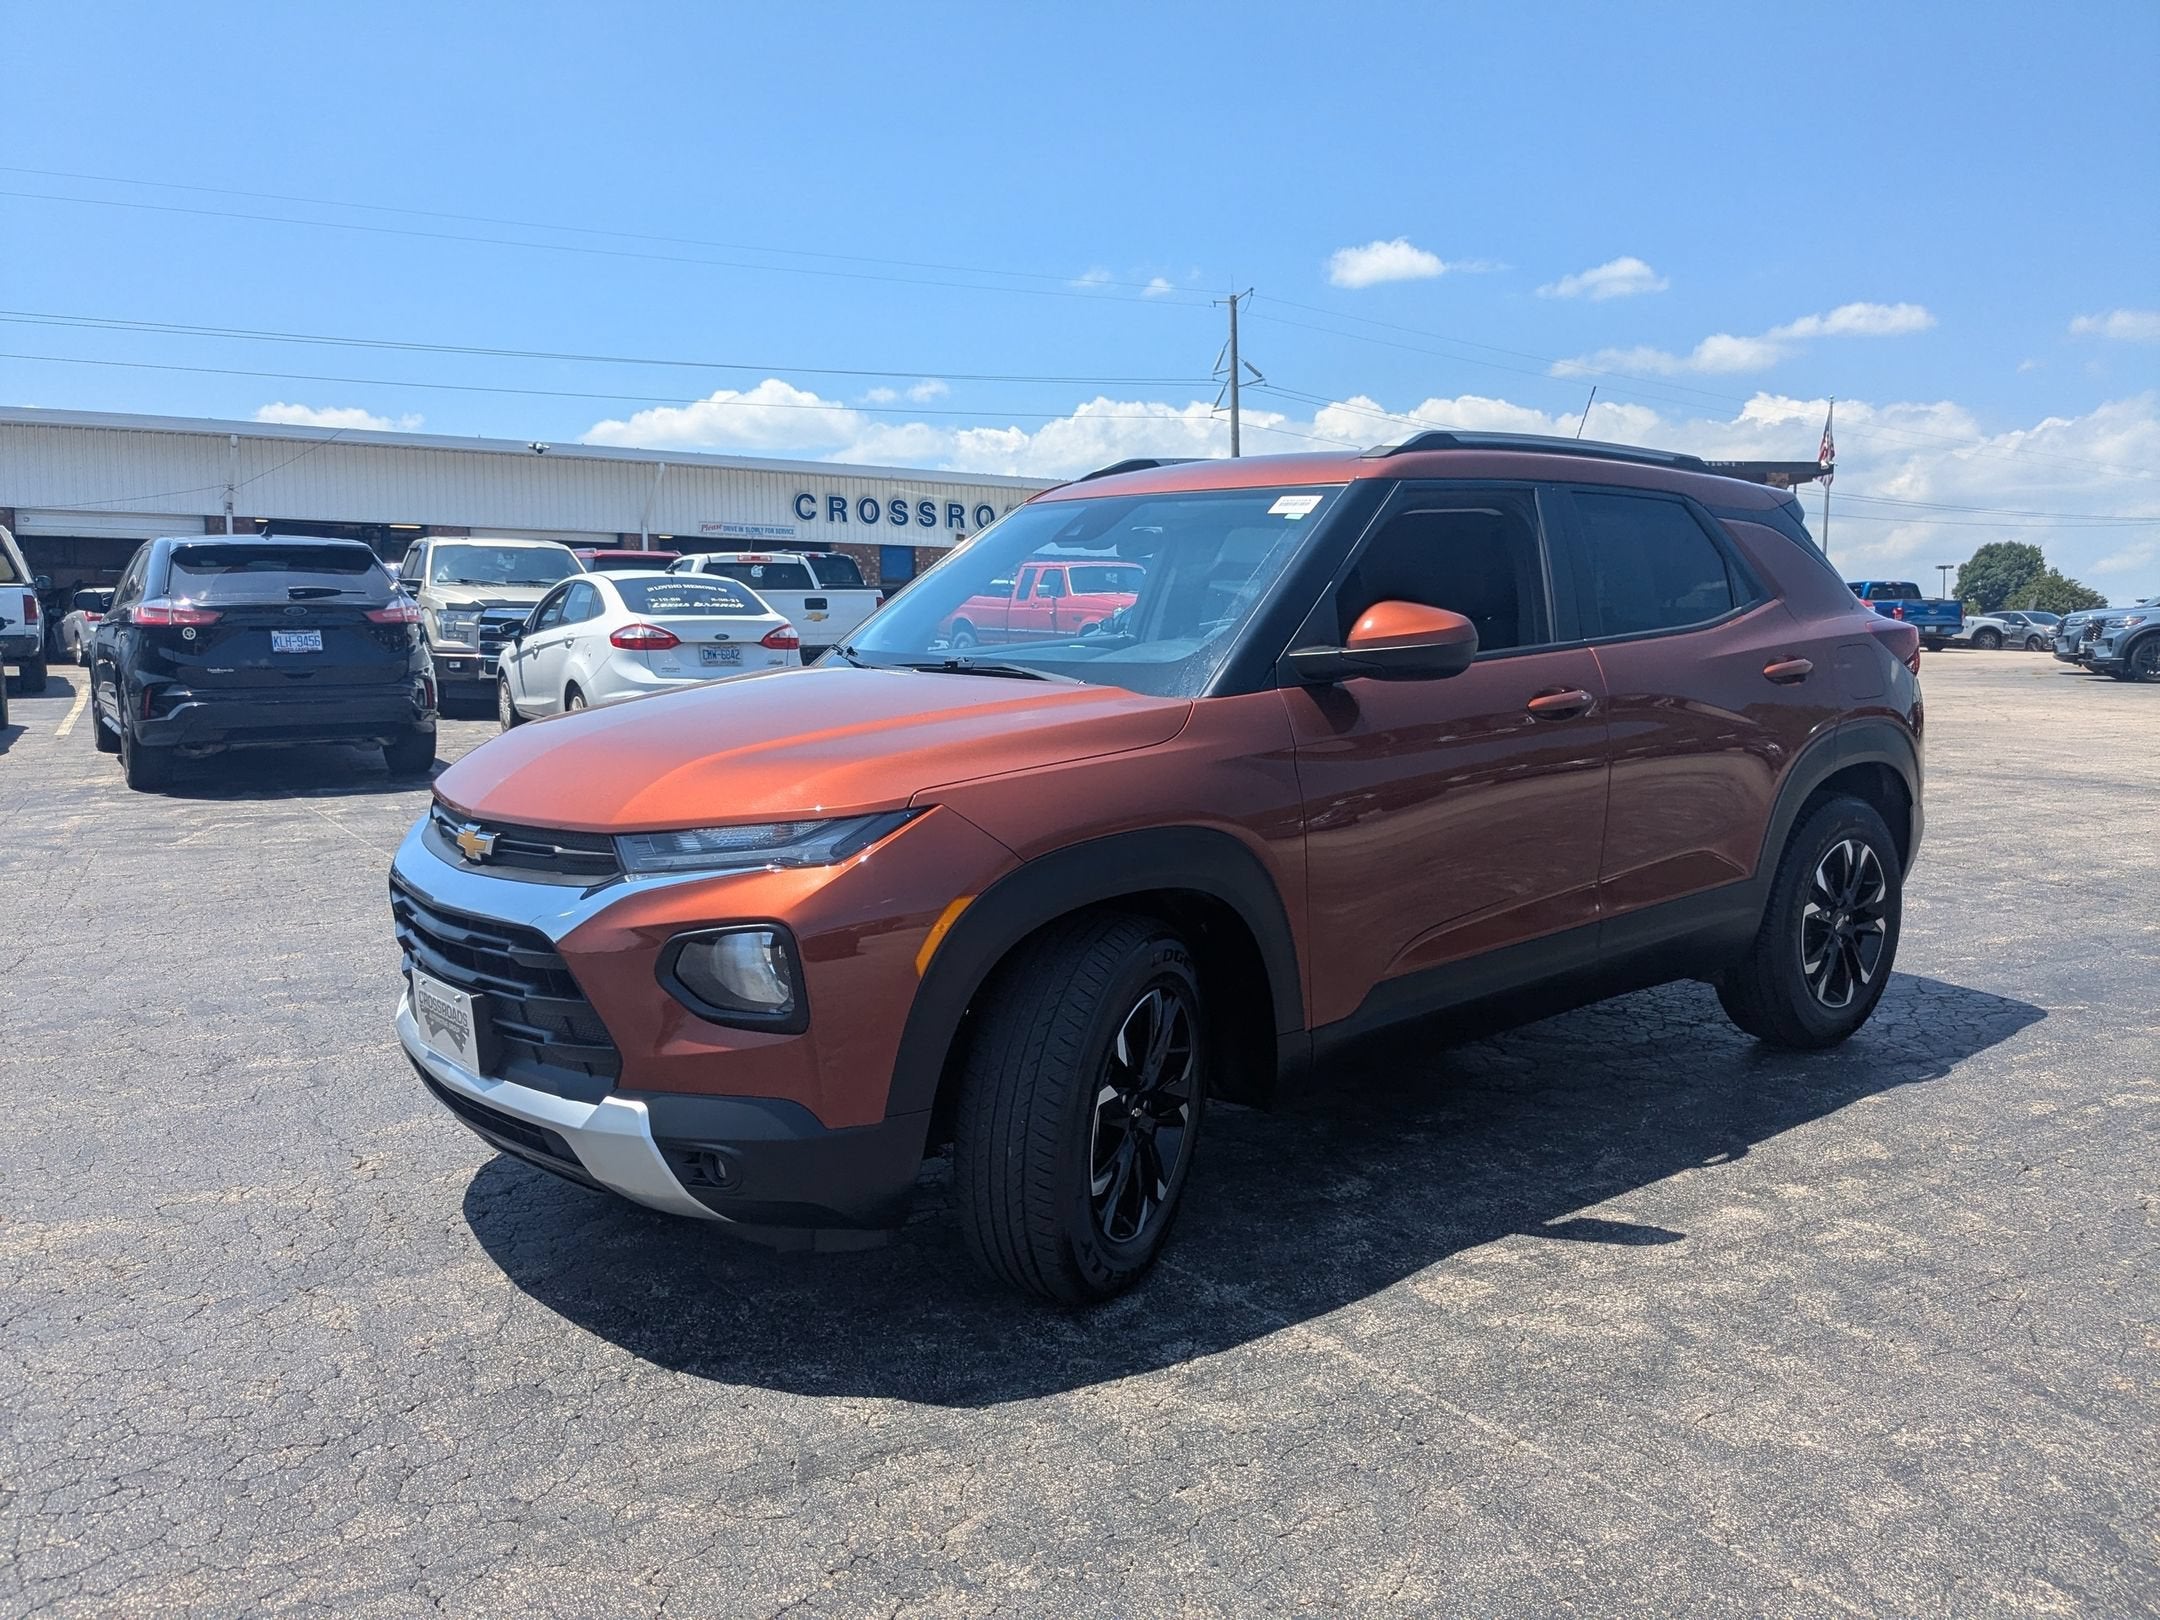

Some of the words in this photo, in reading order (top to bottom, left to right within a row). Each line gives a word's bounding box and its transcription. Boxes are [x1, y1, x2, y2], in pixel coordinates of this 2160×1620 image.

[795, 493, 1016, 529] CROSSRO
[273, 635, 320, 648] KLH-9456
[418, 990, 468, 1027] CROSSROADS
